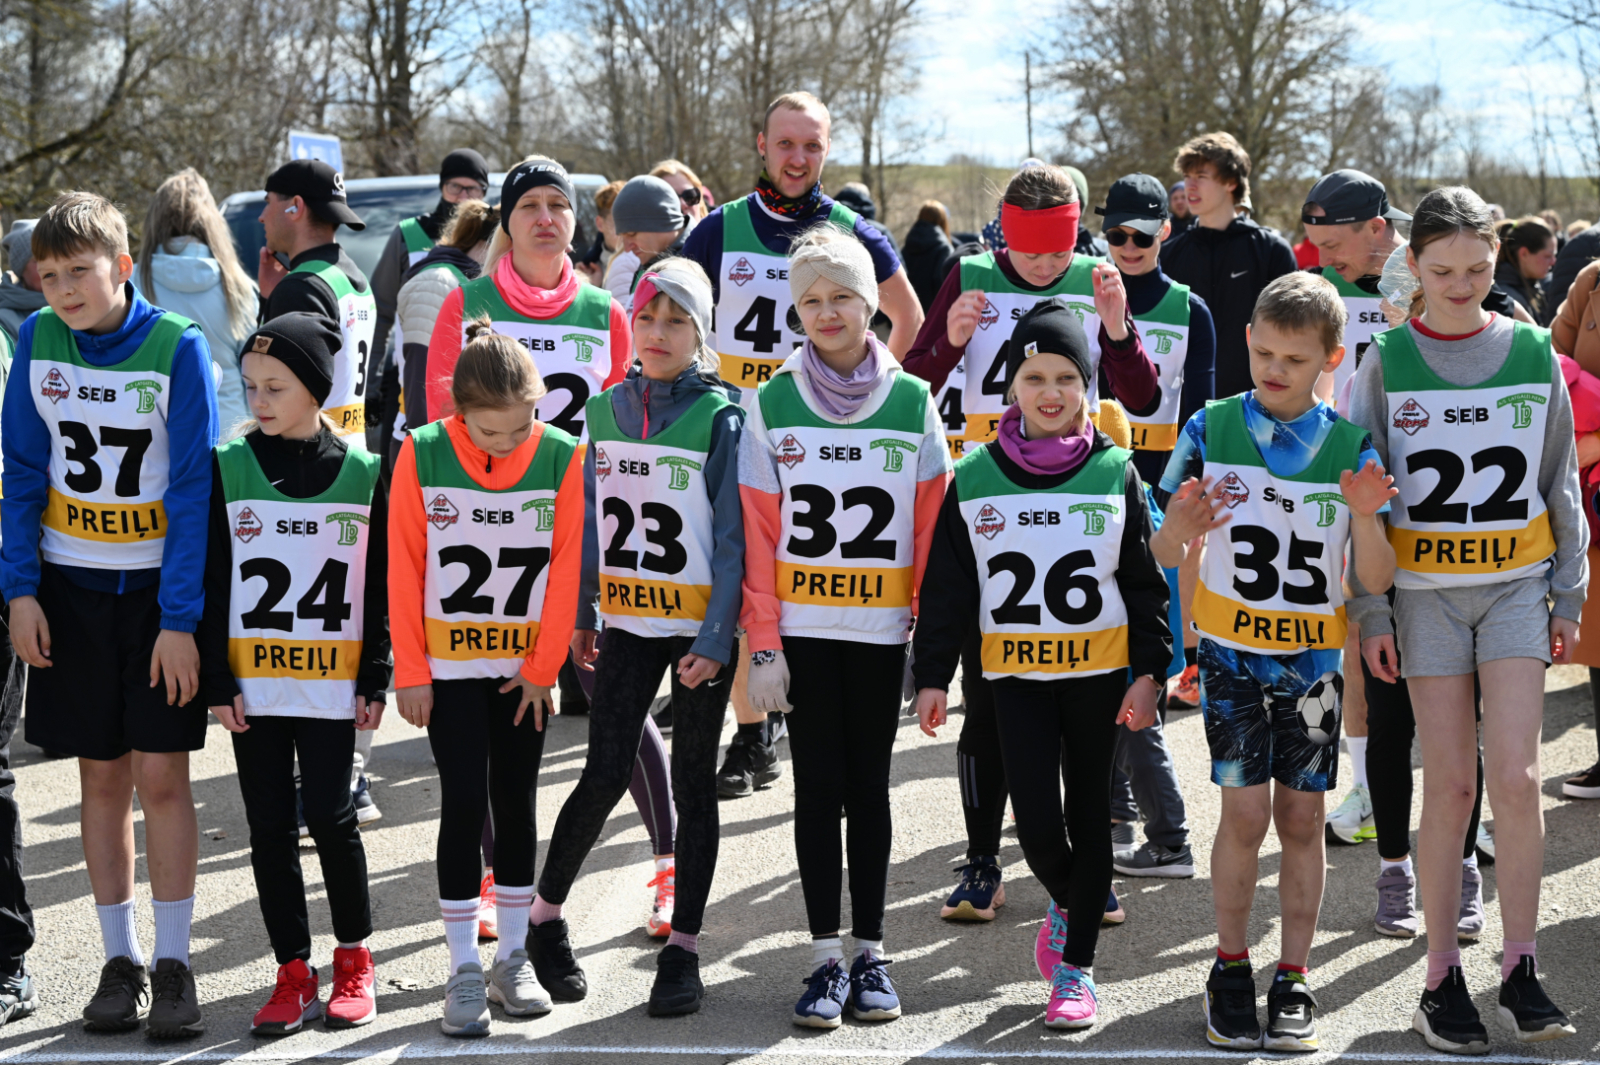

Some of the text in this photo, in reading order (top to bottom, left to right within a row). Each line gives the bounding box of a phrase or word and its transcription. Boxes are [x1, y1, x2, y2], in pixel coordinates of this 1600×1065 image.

[766, 268, 789, 280] SE
[535, 372, 590, 438] 2
[58, 420, 153, 497] 37
[1262, 487, 1295, 513] SB
[1406, 445, 1529, 524] 22
[67, 504, 159, 537] PREIĻI
[602, 496, 688, 575] 23
[786, 483, 897, 561] 32
[1230, 524, 1329, 605] 35
[1414, 537, 1517, 569] PREIĻI
[239, 557, 352, 633] 24
[438, 544, 550, 617] 27
[607, 582, 681, 616] PREIĻI
[792, 570, 883, 605] PREIĻI
[987, 549, 1103, 626] 26
[254, 644, 337, 676] PREIĻI
[450, 627, 531, 655] PREIĻI
[1003, 639, 1090, 668] PREIĻI
